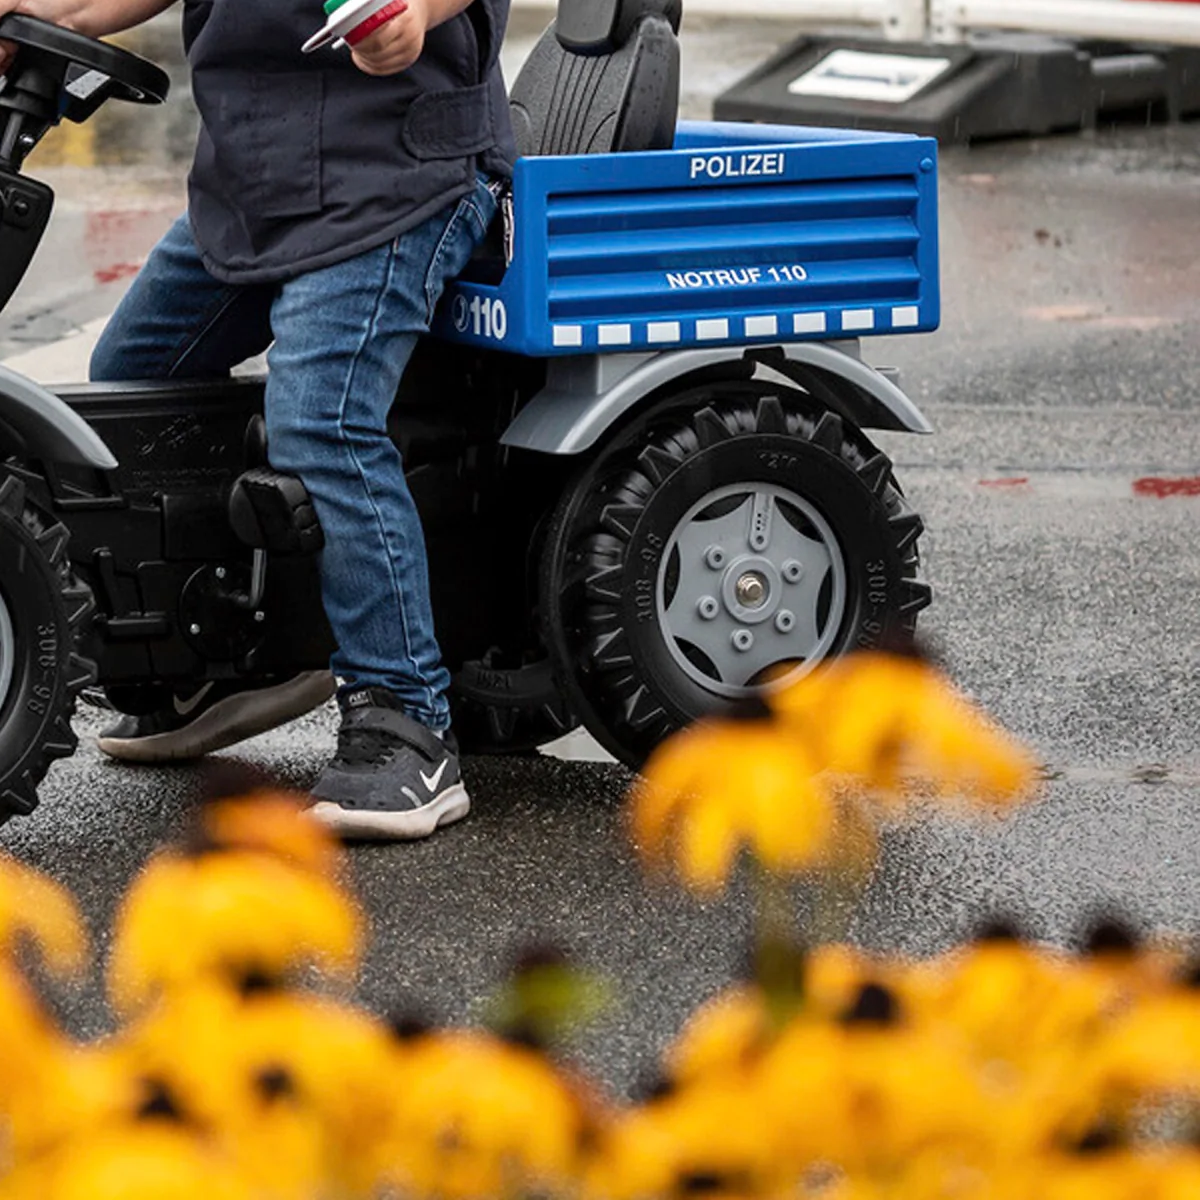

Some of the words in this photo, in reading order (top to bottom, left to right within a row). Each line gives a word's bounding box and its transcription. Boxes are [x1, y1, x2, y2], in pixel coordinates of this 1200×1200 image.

[690, 152, 785, 180] POLIZEI
[665, 267, 761, 290] NOTRUF
[767, 264, 808, 283] 110
[469, 298, 508, 341] 110
